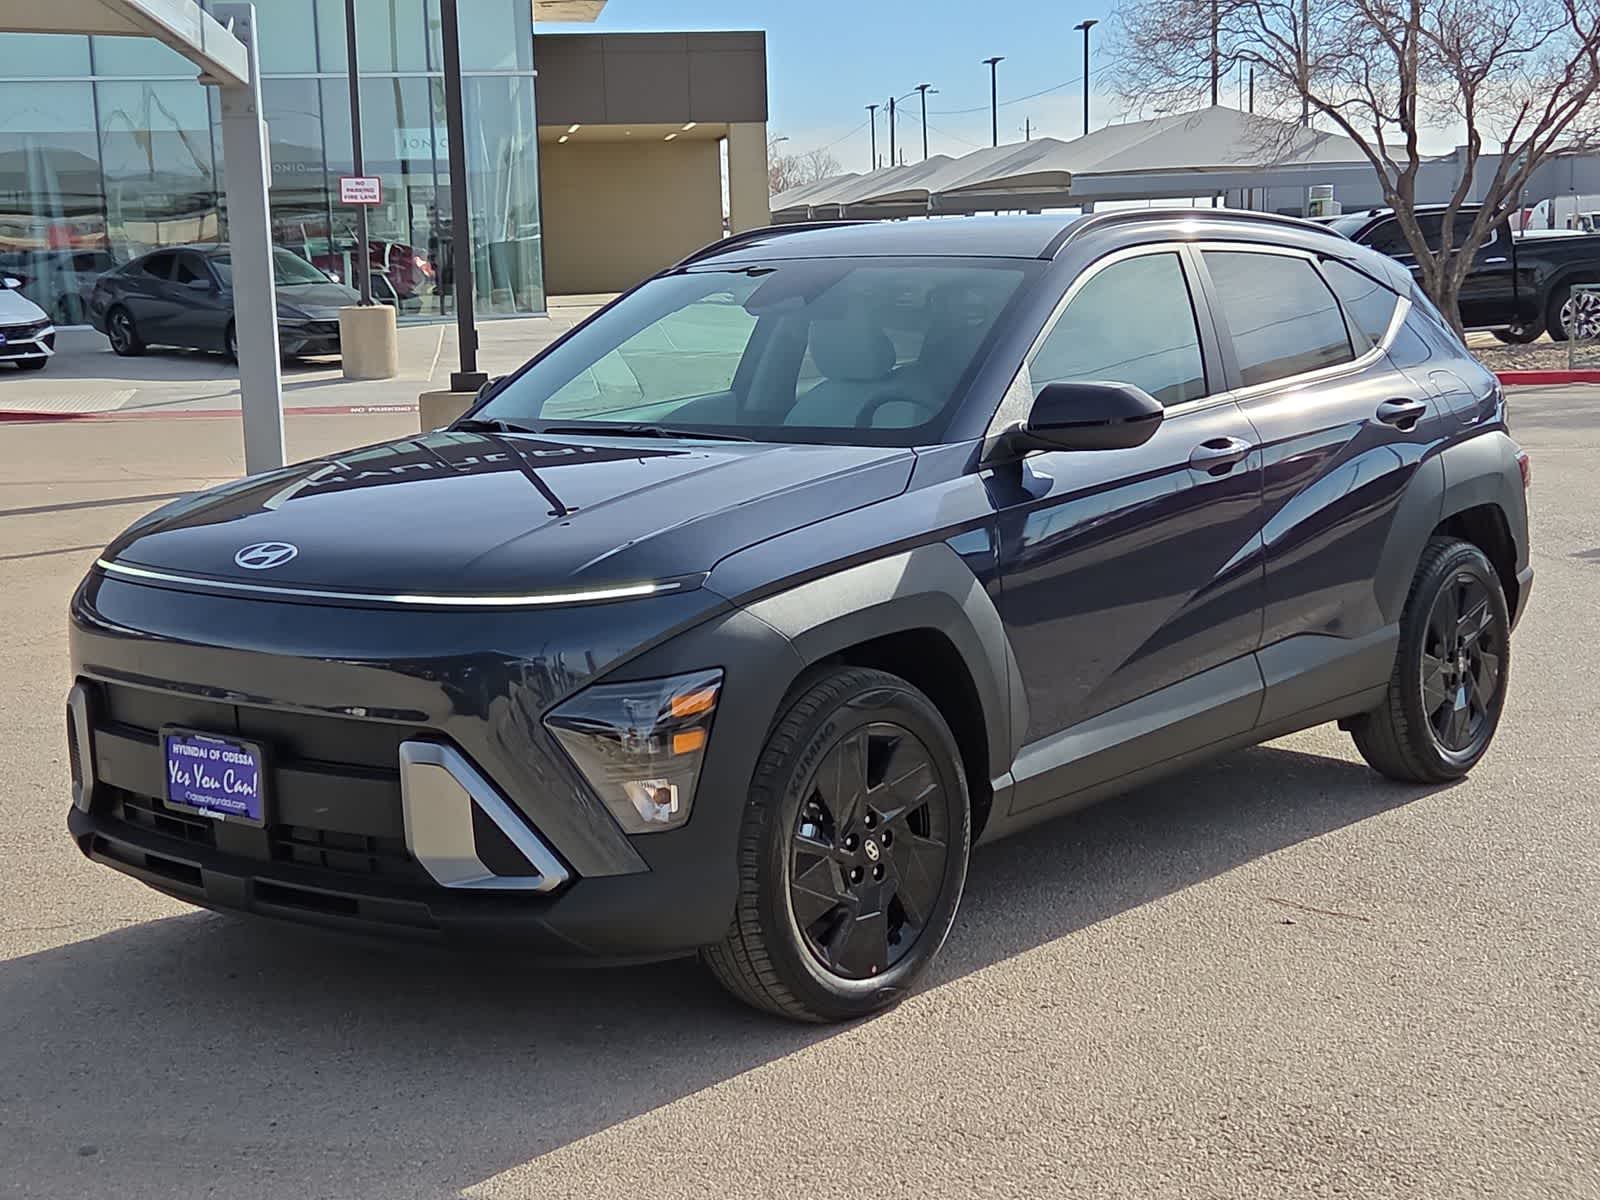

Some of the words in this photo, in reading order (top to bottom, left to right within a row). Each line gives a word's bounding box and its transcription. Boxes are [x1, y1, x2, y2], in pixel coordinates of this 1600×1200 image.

[172, 743, 208, 759] HYUNDAI
[209, 749, 220, 760] OF
[222, 751, 254, 766] ODESSA
[788, 722, 836, 797] KUMHO
[169, 759, 191, 786] Yes
[194, 763, 221, 789] You
[223, 768, 258, 798] Can!
